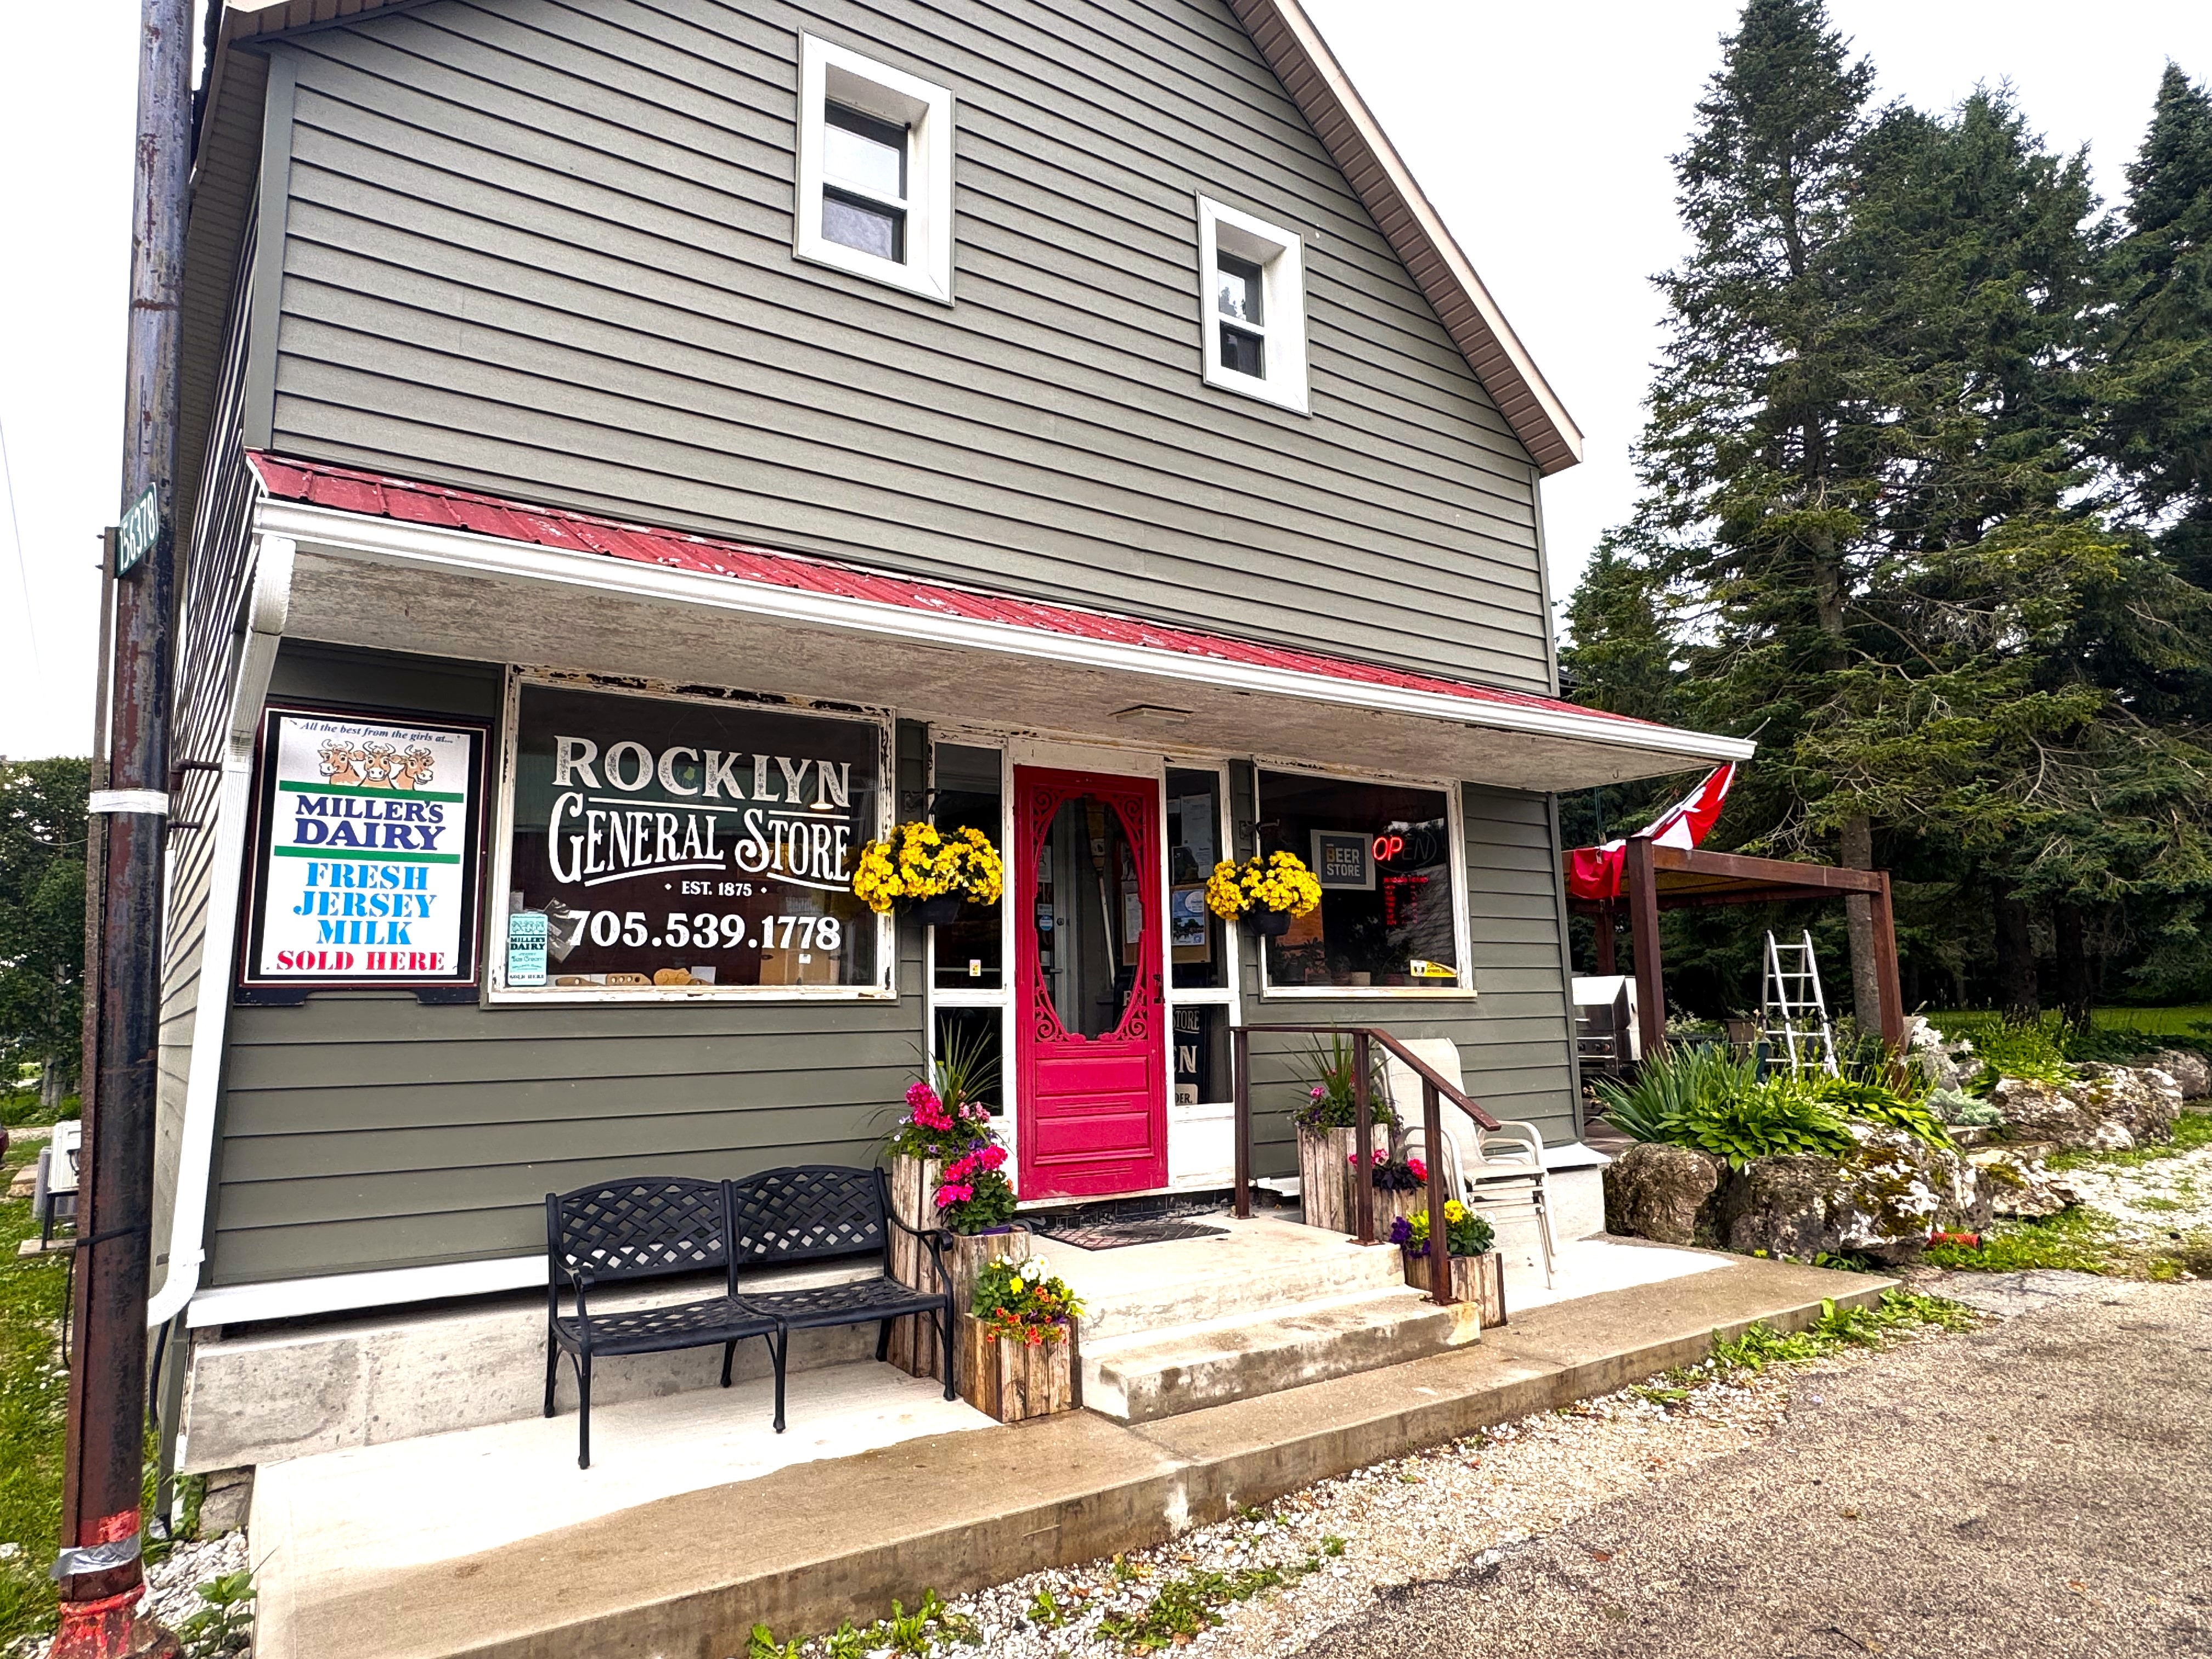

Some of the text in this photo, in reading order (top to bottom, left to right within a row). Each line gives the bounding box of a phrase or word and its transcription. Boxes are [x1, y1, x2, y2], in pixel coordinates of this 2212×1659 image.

[119, 492, 156, 572] 156378
[300, 722, 317, 731] All
[320, 724, 337, 732] the
[341, 725, 360, 735] best
[362, 727, 388, 737] from
[391, 730, 408, 739] the
[409, 732, 432, 742] girls
[552, 735, 851, 808] ROCKLYN
[296, 795, 443, 824] MILLER'S
[293, 818, 446, 850] DAIRY
[548, 792, 851, 883] GENERAL STORE
[1327, 847, 1359, 863] BEER
[306, 862, 429, 890] FRESH
[1327, 864, 1361, 877] STORE
[681, 881, 753, 896] EST. 1875
[293, 891, 437, 918] JERSEY
[316, 920, 412, 945] MILK
[567, 910, 841, 951] 705.539.1778
[276, 950, 444, 970] SOLD HERE
